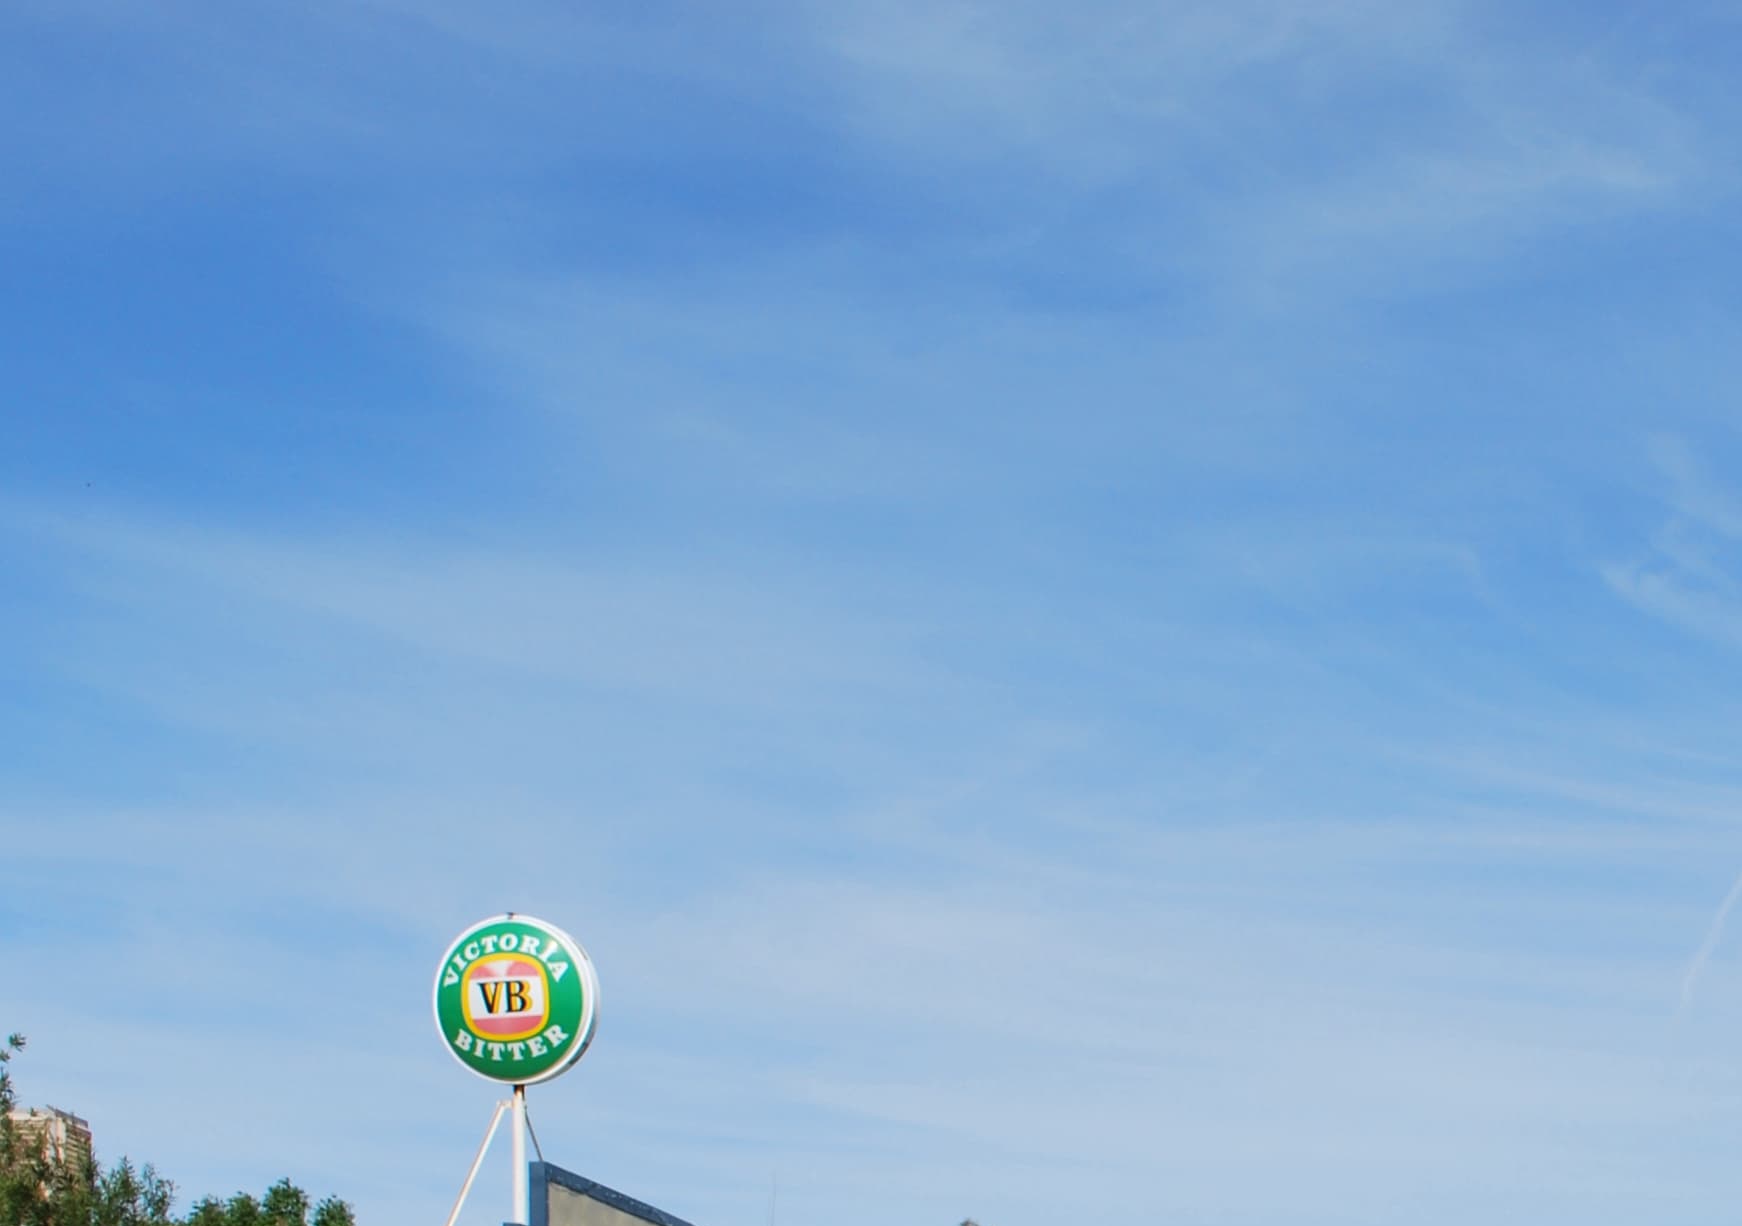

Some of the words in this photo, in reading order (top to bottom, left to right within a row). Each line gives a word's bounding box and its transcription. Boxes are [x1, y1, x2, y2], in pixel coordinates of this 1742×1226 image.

[443, 933, 568, 988] VICTORIA
[478, 980, 533, 1014] VB
[454, 1024, 569, 1061] BITTER
